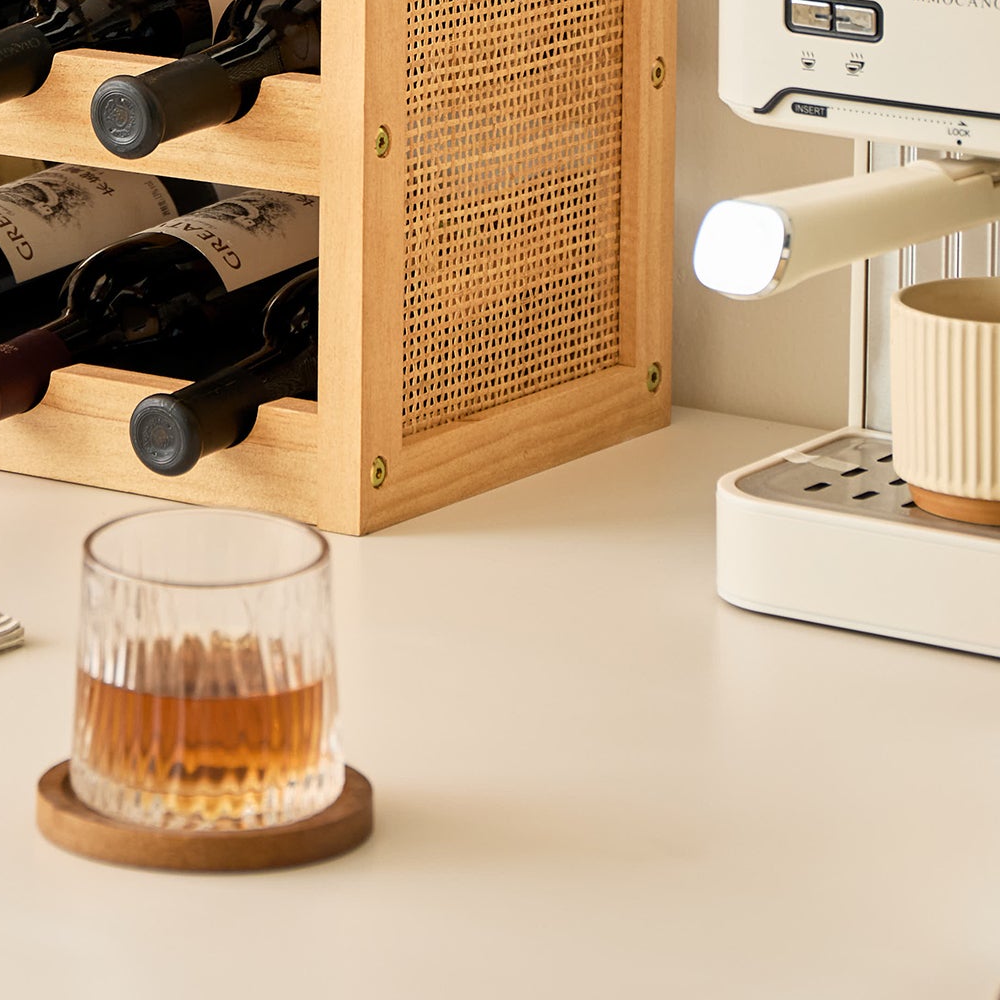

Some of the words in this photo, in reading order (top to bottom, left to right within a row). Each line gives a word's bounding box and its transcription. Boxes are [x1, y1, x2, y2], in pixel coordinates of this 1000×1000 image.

[794, 104, 826, 116] INSERT
[947, 127, 970, 137] LOCK
[160, 221, 242, 271] GREAT
